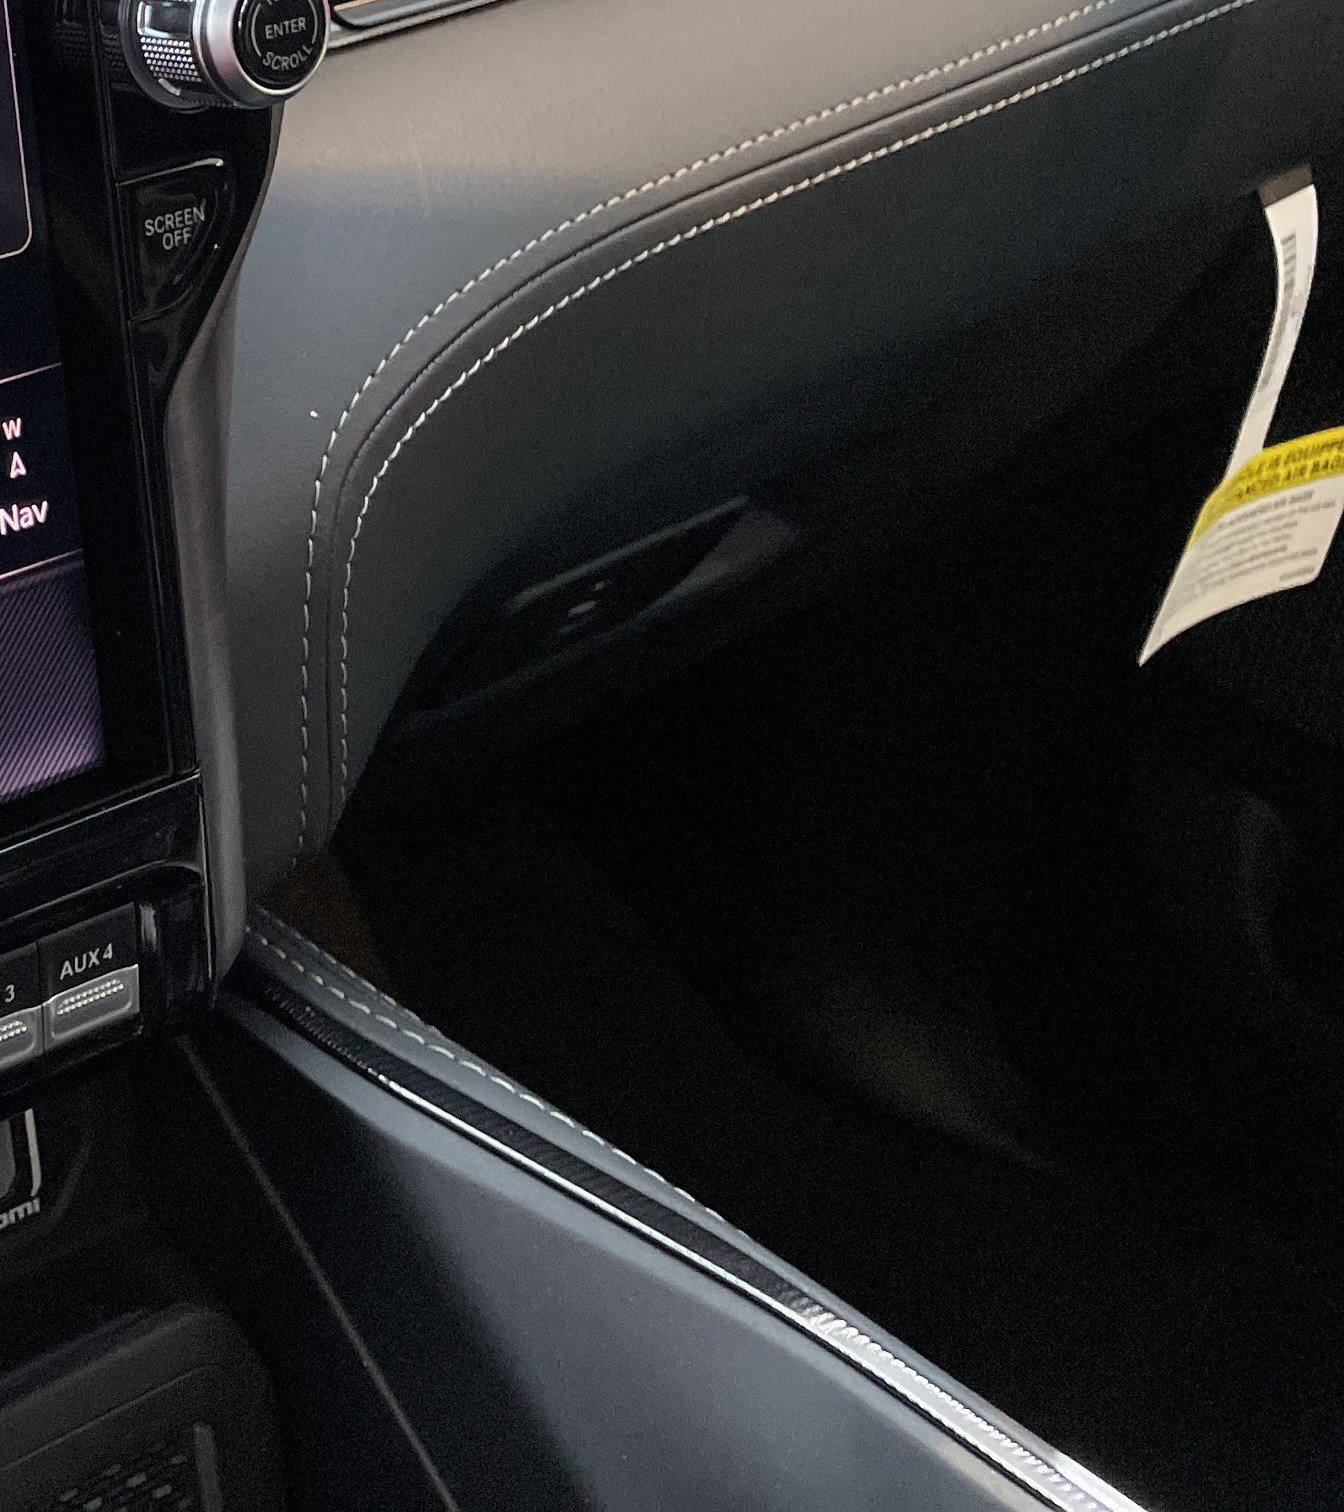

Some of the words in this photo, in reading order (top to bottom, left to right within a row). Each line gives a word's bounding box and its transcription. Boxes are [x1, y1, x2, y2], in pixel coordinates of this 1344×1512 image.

[265, 16, 307, 40] ENTER
[262, 44, 315, 71] SCROLL
[144, 205, 206, 238] SCREEN
[162, 229, 193, 250] OFF
[3, 418, 22, 439] W
[59, 954, 100, 980] AUX
[100, 942, 114, 962] 4
[3, 984, 16, 1003] 3
